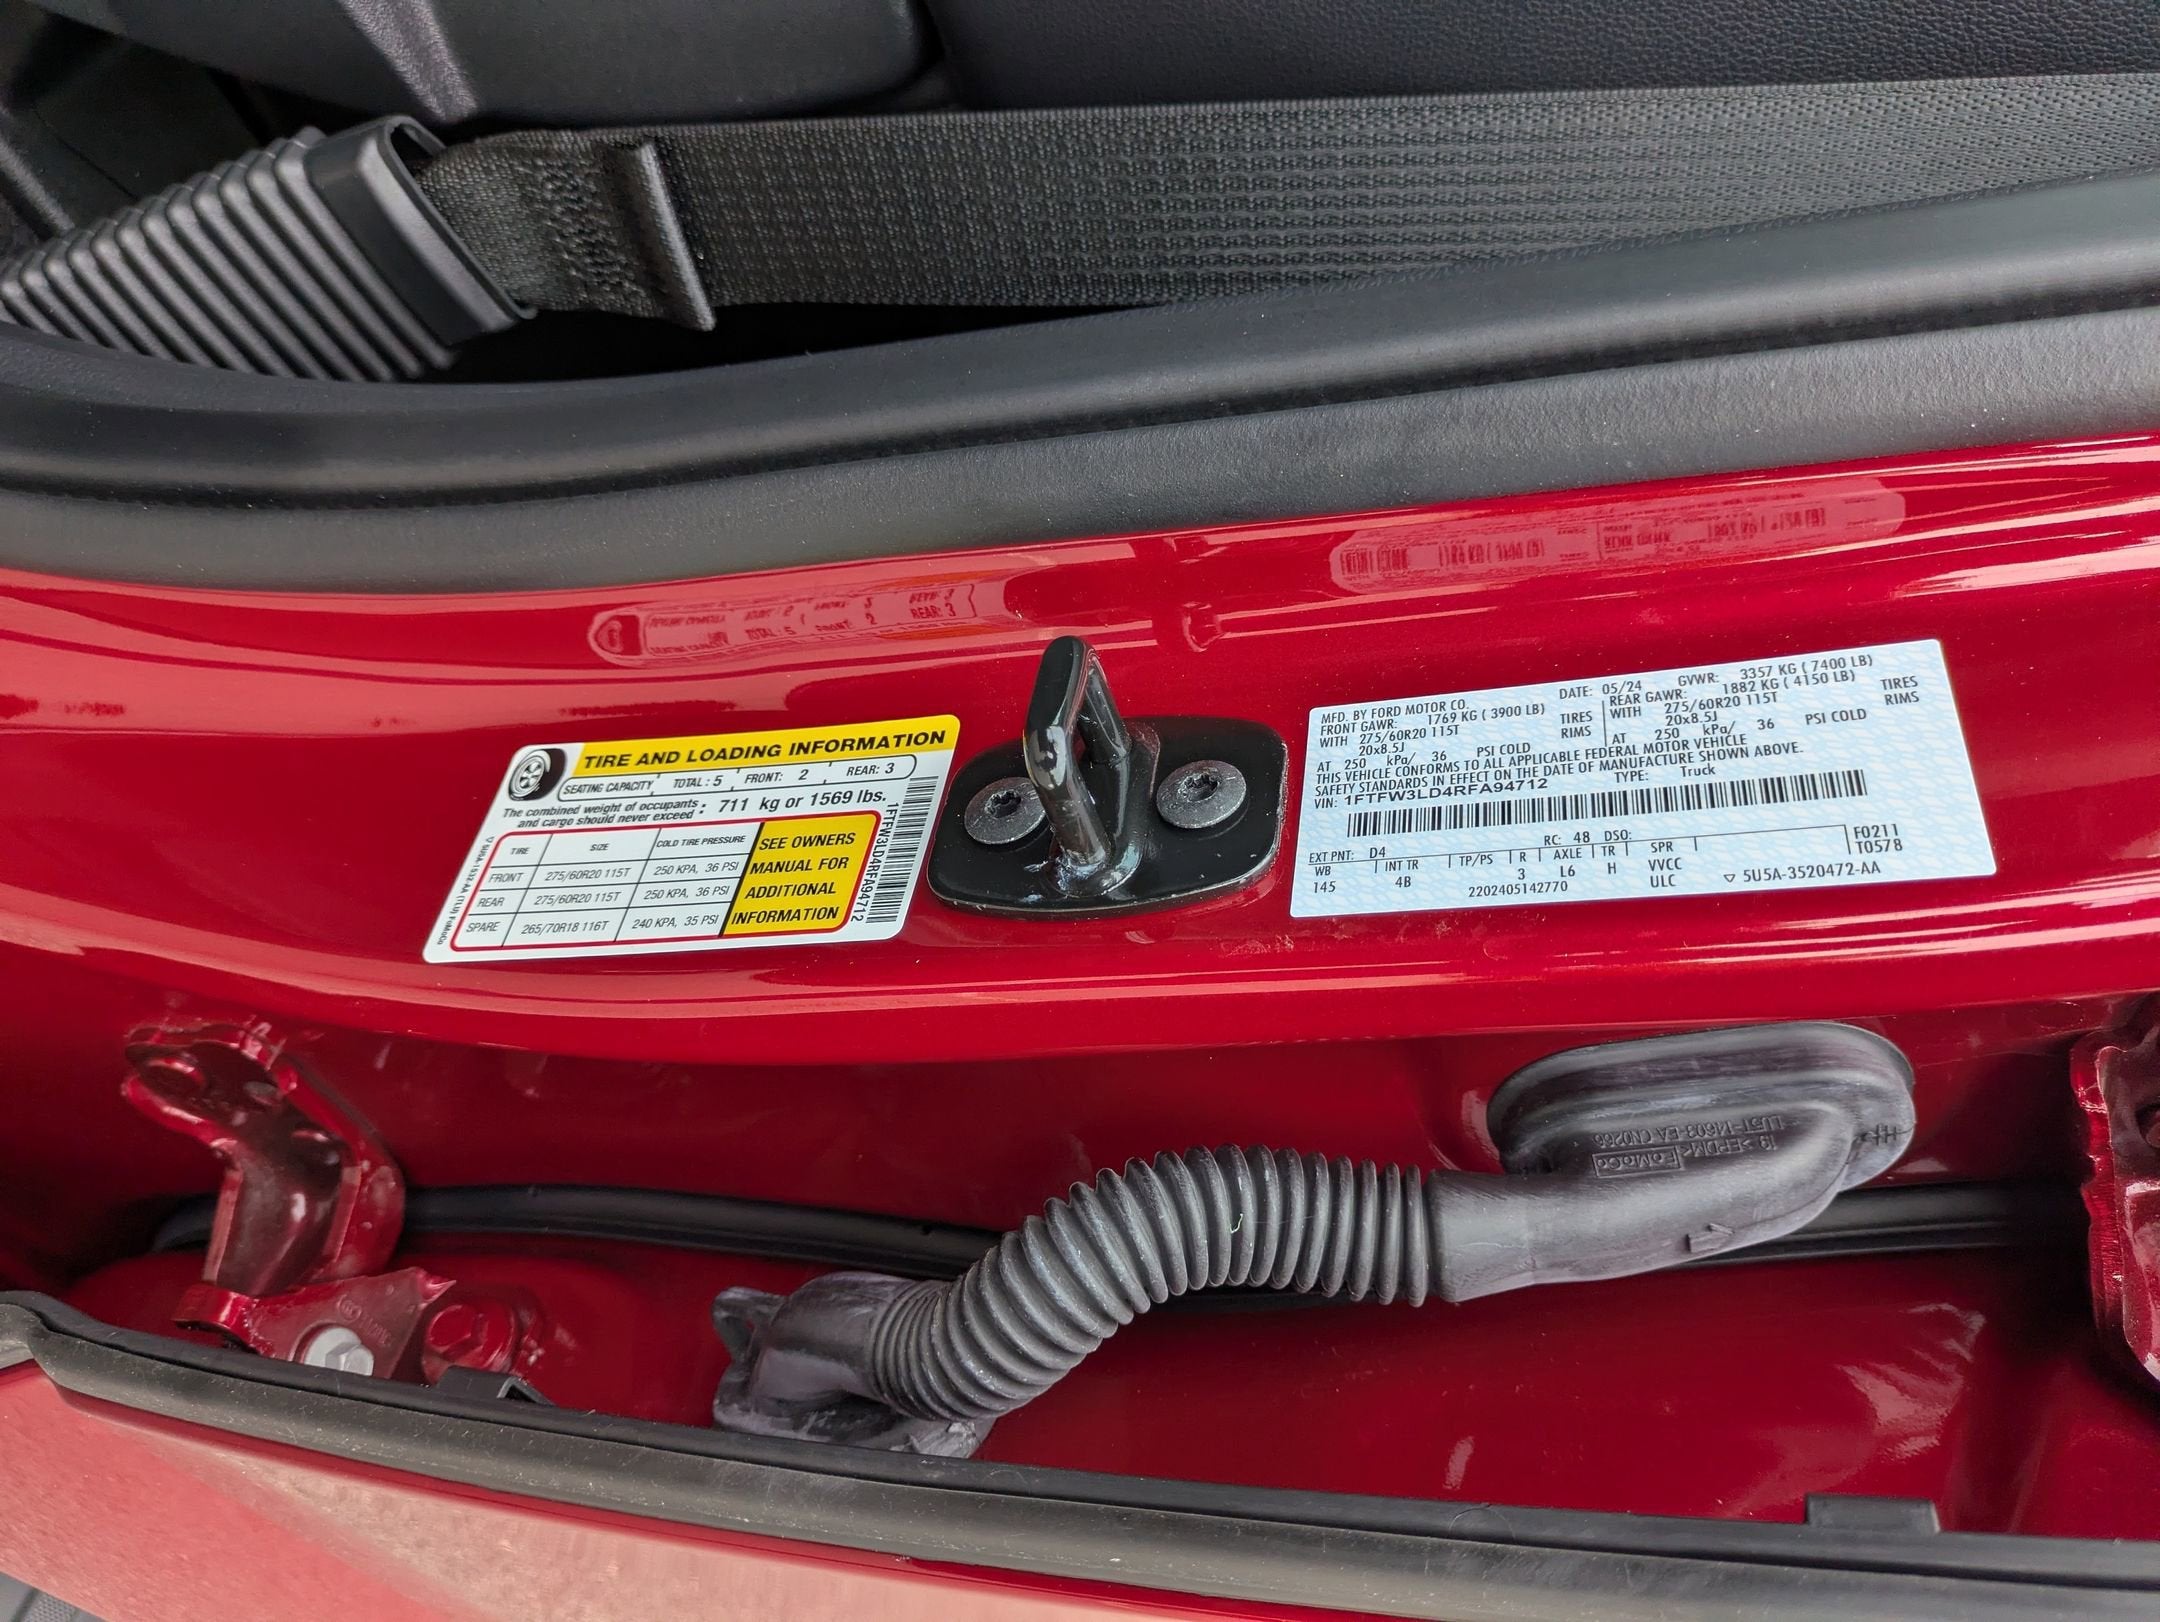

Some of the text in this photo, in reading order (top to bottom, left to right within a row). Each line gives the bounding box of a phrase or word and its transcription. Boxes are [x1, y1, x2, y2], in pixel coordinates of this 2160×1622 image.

[1559, 655, 1873, 699] DATE: 05/24 GVWR: 3357 KG 7400 LB)
[1610, 669, 1855, 706] REAR GAWR: 1882 KG 4150 LB)
[1321, 699, 1469, 724] MFD. BY FORD MOTOR CO.
[1610, 676, 1918, 719] WITH 275/60R20 115T TIRES
[1666, 691, 1919, 726] 20x8.5J RIMS
[1320, 703, 1545, 736] FRONT GAWR: 1769 KG 3900 LB)
[1320, 711, 1592, 747] WITH 275/60R20 115T TIRES
[1613, 709, 1867, 744] AT 250 kPa/ 36 PSI COLD
[584, 731, 946, 768] TIRE AND LOADING INFORMATION
[1359, 726, 1591, 756] 20x8.5J RIMS
[1316, 742, 1804, 797] SAFETY STANDARDS IN EFFECT ON THE DATE OF MANUFACTURE SHOWN ABOVE.
[1317, 743, 1531, 772] AT 250 kPa/ 36 PSI COLD
[1317, 734, 1747, 784] THIS VEHICLE CONFORMS TO ALL APPLICABLE FEDERAL MOTOR VEHICLE
[564, 763, 895, 794] SEATING CAPACITY 5 FRONT: 2 REAR: 3
[1314, 764, 1716, 809] VIN: 1FTFW3LD4RFA94712 TYPE: Truck
[503, 799, 698, 818] The combined weight of occupants
[718, 790, 887, 812] 711 kg or 1569 lbs.
[518, 811, 694, 828] and cargo should never exceed
[1854, 824, 1898, 839] F0211
[590, 843, 609, 851] SIZE
[656, 839, 679, 848] COLD
[681, 837, 700, 846] TIRE
[702, 835, 746, 844] PRESSURE
[759, 833, 856, 850] SEE OWNERS
[1309, 829, 1632, 863] EXT PNT: D4 RC: 48 DSO:
[1855, 839, 1903, 854] T0578
[488, 862, 740, 883] FRONT 275/60R20 115T 250 KPA, 36 PSI
[749, 856, 849, 874] MANUAL FOR
[851, 802, 898, 922] 1FTFW3LD4RFA94712
[1315, 842, 1674, 876] WB INT TR TP/PS SPR
[1743, 861, 1881, 882] 5U5A-3520472-AA
[1314, 857, 1682, 893] 145 4B VVCC
[1468, 874, 1676, 898] 2202405142770 ULC
[745, 882, 836, 900] ADDITIONAL
[437, 916, 456, 945] FoMoCo
[466, 915, 719, 936] SPARE 265/70R18 116T 240 KPA, 35 PSI
[731, 907, 839, 925] INFORMATION
[1597, 1152, 1678, 1169] FoMoCo
